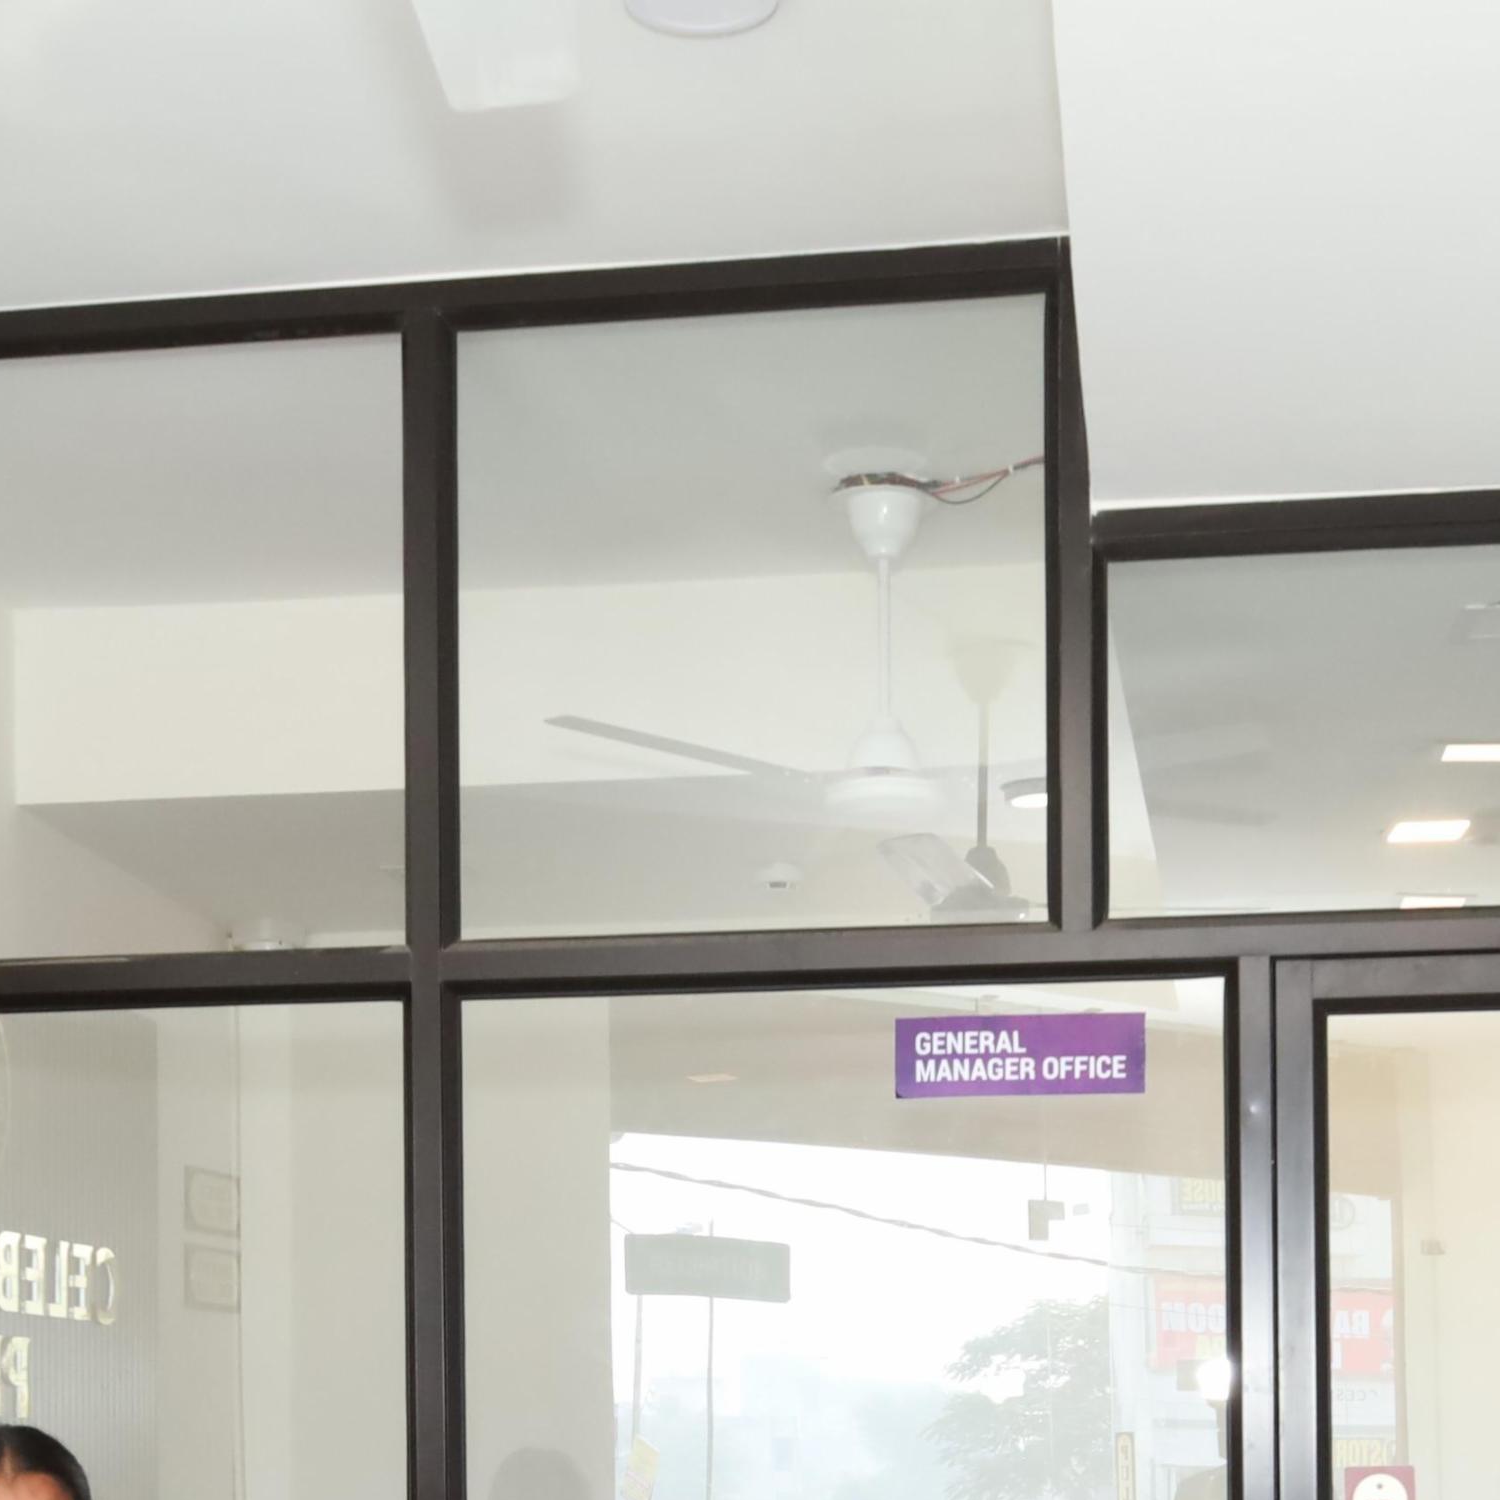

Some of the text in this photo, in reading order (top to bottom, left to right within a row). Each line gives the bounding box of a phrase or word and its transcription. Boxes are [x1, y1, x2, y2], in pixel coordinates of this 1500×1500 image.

[915, 1030, 1027, 1056] GENERAL
[915, 1055, 1127, 1083] MANAGER OFFICE
